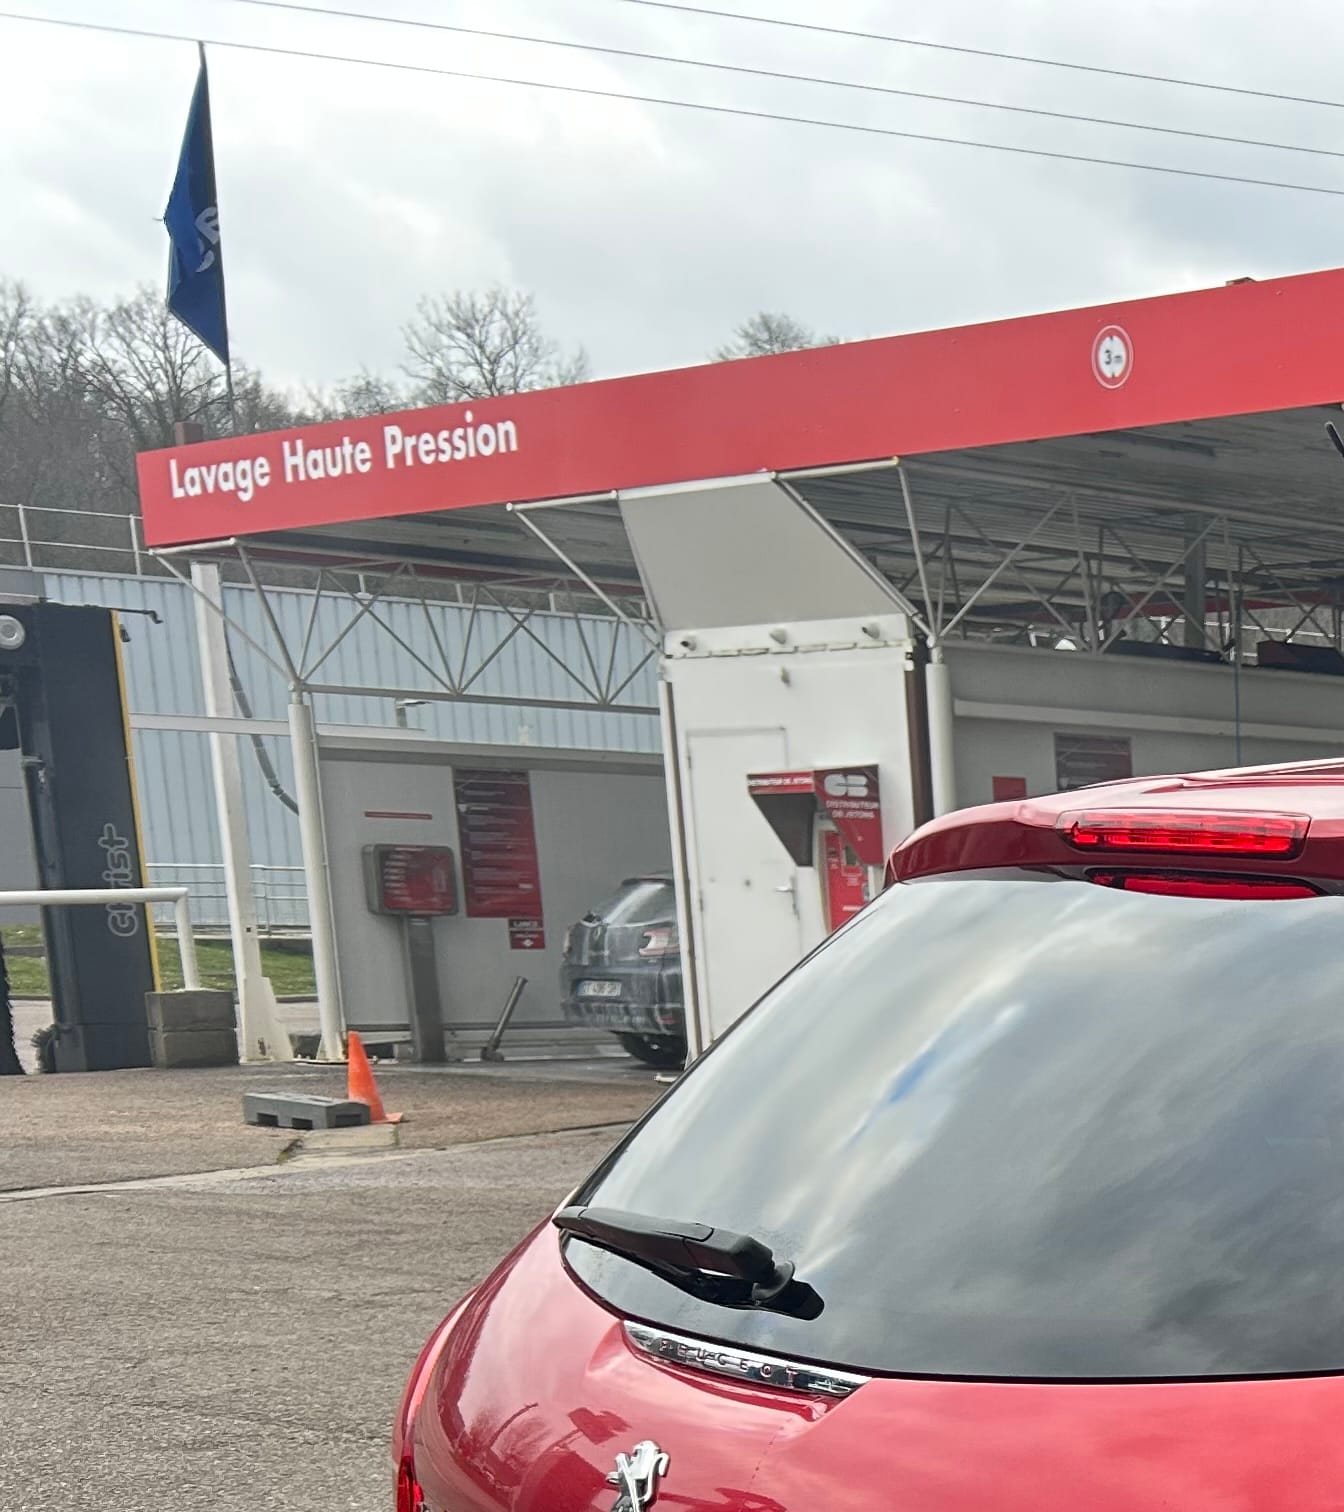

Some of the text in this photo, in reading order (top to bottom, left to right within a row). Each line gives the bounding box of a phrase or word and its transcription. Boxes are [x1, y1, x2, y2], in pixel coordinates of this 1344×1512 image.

[1104, 349, 1112, 366] 3
[169, 410, 519, 502] Lavage Haute Pression
[659, 1337, 798, 1390] PEUGEOT
